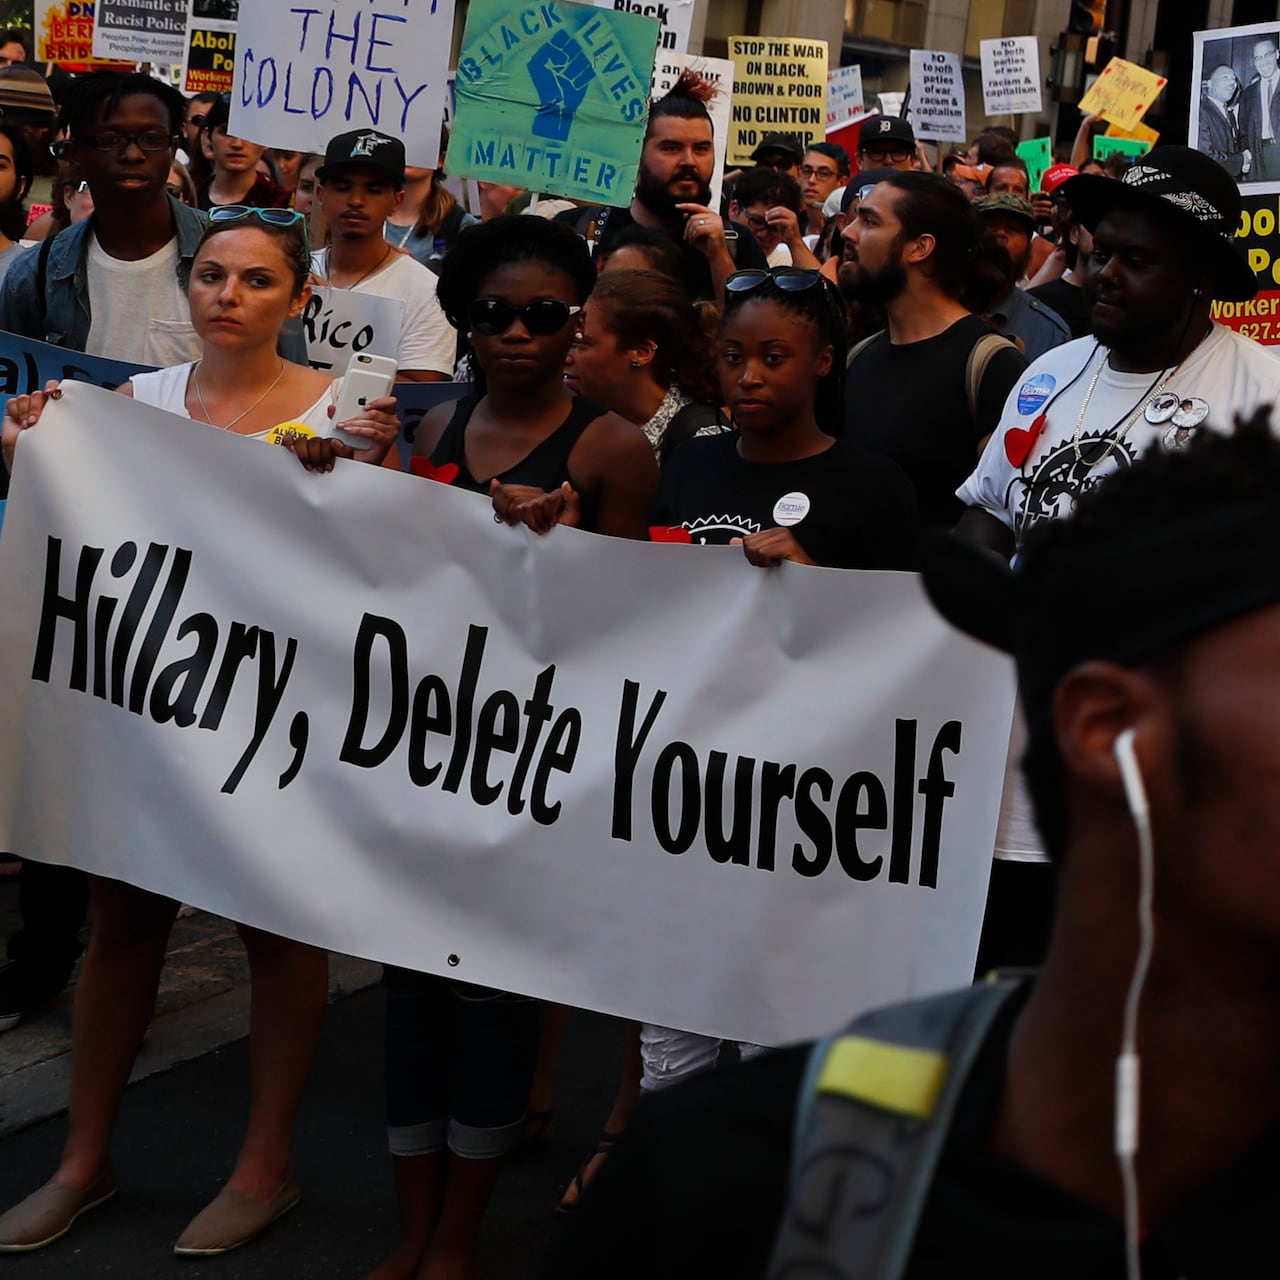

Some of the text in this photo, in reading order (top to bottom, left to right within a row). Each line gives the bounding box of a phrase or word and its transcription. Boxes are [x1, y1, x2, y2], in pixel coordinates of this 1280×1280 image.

[69, 2, 96, 17] DN
[104, 11, 187, 32] Racist Police
[192, 31, 235, 51] Abol
[290, 8, 407, 73] THE
[1001, 40, 1015, 48] NO
[734, 41, 823, 59] STOP THE WAR
[1004, 48, 1024, 56] both
[459, 1, 644, 122] BLACK LIVES
[746, 61, 761, 75] ON
[923, 63, 932, 72] to
[994, 58, 1025, 67] parties
[188, 69, 232, 83] Workers
[988, 76, 1031, 88] racism &
[242, 48, 428, 133] COLONY
[733, 81, 774, 96] BROWN
[776, 85, 785, 96] &
[788, 84, 822, 98] POOR
[925, 85, 934, 93] of
[986, 86, 1036, 98] capitalism
[920, 97, 958, 106] racism &
[733, 106, 751, 122] NO
[755, 106, 820, 124] CLINTON
[738, 130, 757, 146] NO
[474, 140, 617, 190] MATTER
[30, 534, 963, 891] Hillary, Delete Yourself
